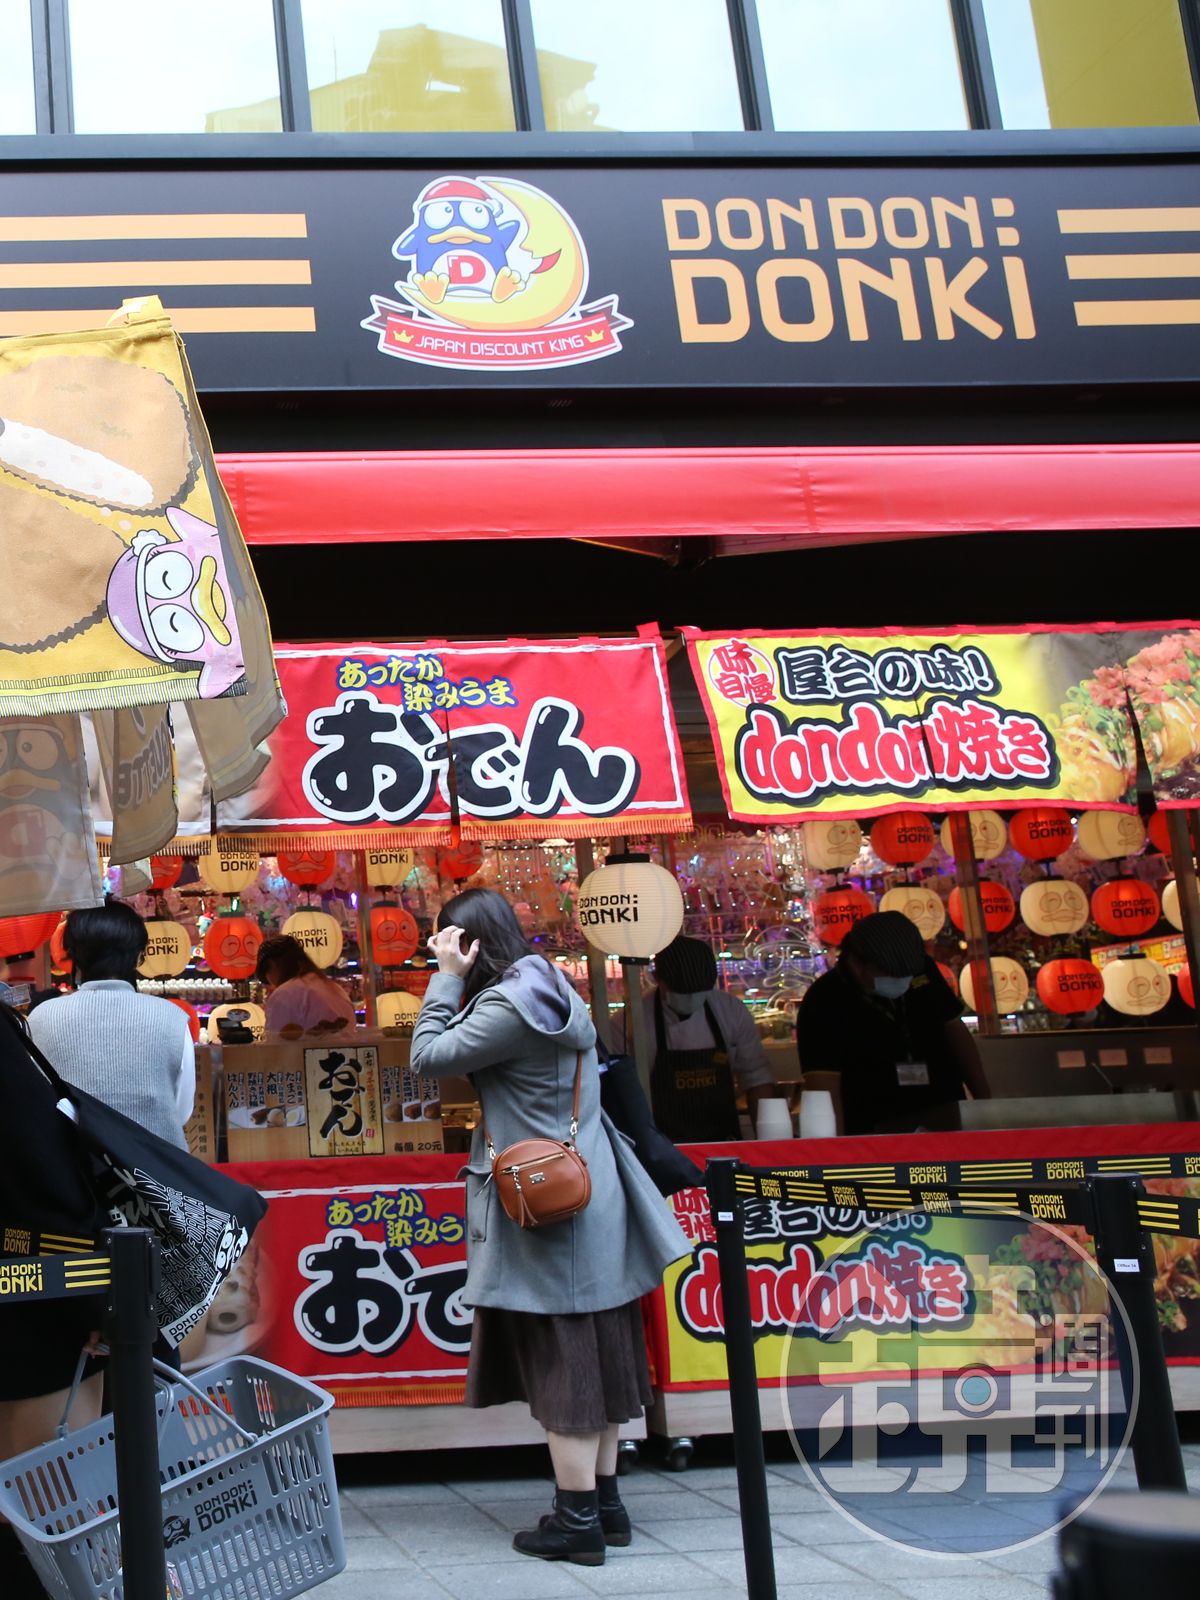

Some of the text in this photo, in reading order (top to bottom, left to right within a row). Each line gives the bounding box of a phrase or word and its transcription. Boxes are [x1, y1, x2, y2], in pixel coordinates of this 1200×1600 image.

[662, 198, 817, 251] DON
[447, 255, 486, 284] D
[670, 257, 1036, 343] DONKI
[416, 335, 584, 356] JAPAN DISCOUNT KING
[339, 656, 443, 688] あったか
[783, 649, 992, 697] 屋台の味!
[404, 678, 515, 712] 染みうま
[306, 696, 632, 816] おでん
[221, 861, 257, 872] DONKI
[580, 907, 638, 926] DONKI
[144, 945, 178, 956] ONKI
[299, 937, 328, 947] ONKI
[1046, 1162, 1062, 1170] DON
[1047, 1168, 1085, 1180] DONKI
[910, 1173, 947, 1184] DONKI
[328, 1191, 423, 1226] あったか
[1029, 1195, 1044, 1204] DON
[1031, 1204, 1066, 1219] DONKI
[387, 1216, 463, 1248] 染みう
[4, 1238, 30, 1254] DONKI
[298, 1234, 471, 1348] おで
[194, 1496, 221, 1516] DON
[198, 1490, 258, 1532] DONKI
